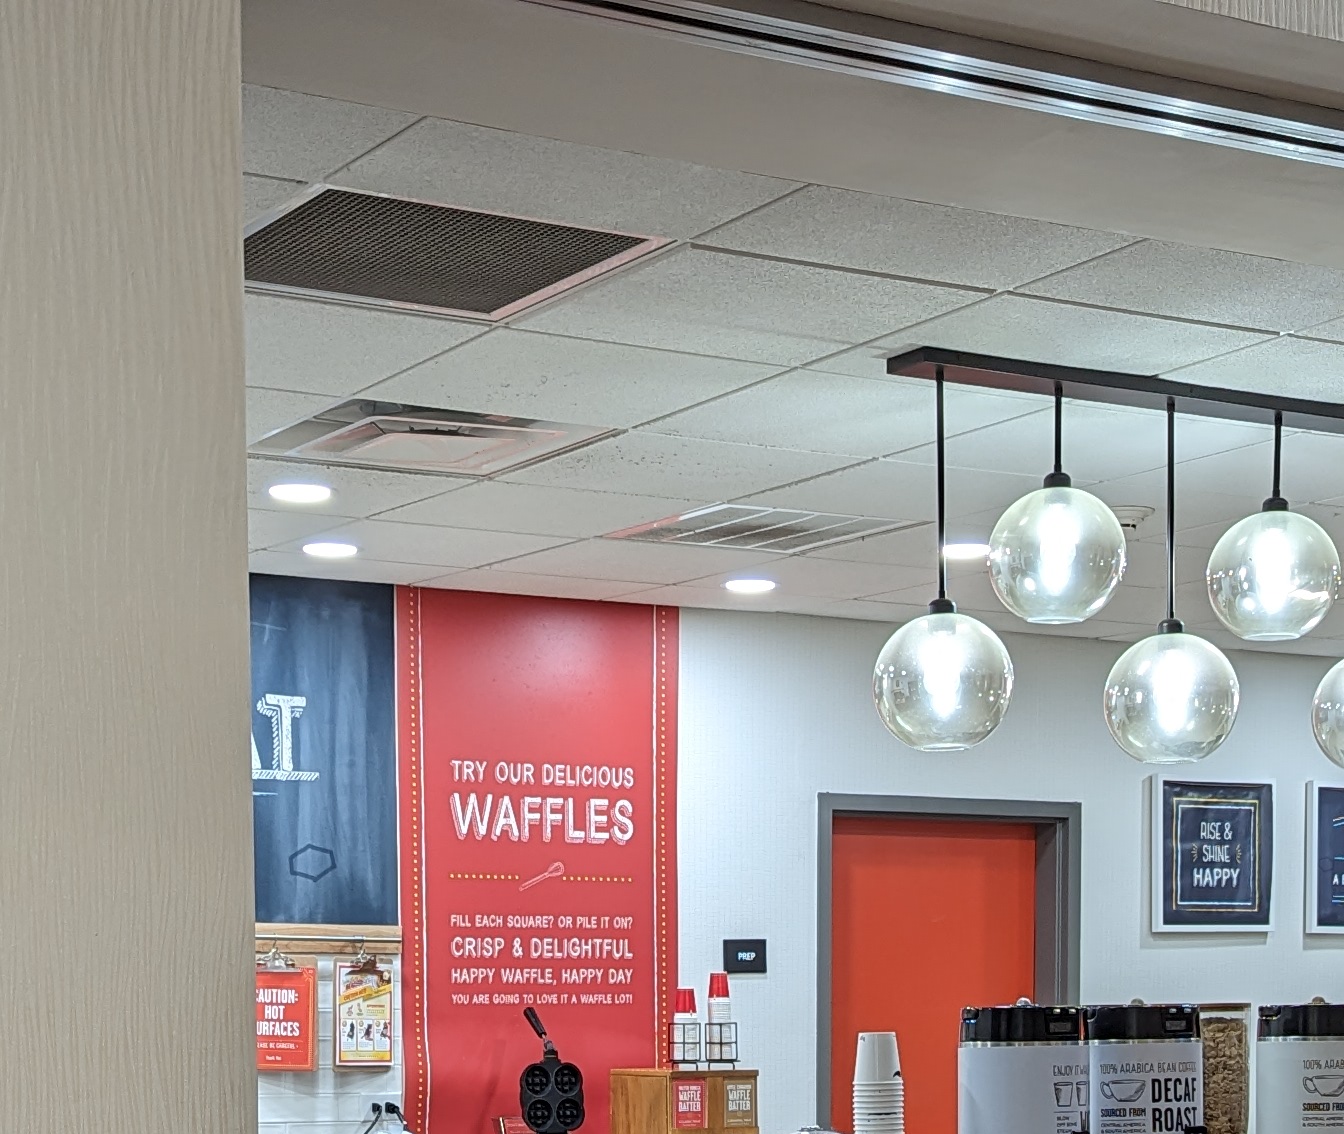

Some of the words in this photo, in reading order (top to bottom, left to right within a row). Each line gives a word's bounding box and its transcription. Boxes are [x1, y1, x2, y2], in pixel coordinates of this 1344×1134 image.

[450, 760, 487, 783] TRY
[495, 761, 535, 785] OUR
[542, 764, 634, 789] DELICIOUS
[450, 792, 634, 845] WAFFLES
[1200, 822, 1221, 840] RISE
[1223, 823, 1233, 840] &
[1202, 845, 1230, 863] SHINE
[1193, 868, 1240, 888] HAPPY
[1332, 874, 1339, 885] A
[450, 914, 471, 928] FILL
[475, 915, 503, 928] EACH
[507, 915, 554, 929] SQUARE?
[558, 916, 573, 929] OR
[576, 916, 597, 929] PILE
[600, 916, 610, 929] IT
[613, 916, 633, 929] ON?
[450, 937, 505, 958] CRISP
[512, 937, 523, 958] &
[530, 938, 633, 960] DELIGHTFUL
[737, 952, 756, 961] PREP
[451, 968, 495, 984] HAPPY
[501, 968, 556, 986] WAFFLE,
[561, 968, 604, 985] HAPPY
[608, 968, 633, 985] DAY
[451, 994, 469, 1004] YOU
[472, 994, 490, 1004] ARE
[492, 994, 520, 1005] GOING
[523, 994, 534, 1004] TO
[536, 994, 558, 1004] LOVE
[560, 994, 569, 1004] IT
[571, 994, 578, 1004] A
[580, 994, 612, 1004] WAFFLE
[614, 994, 633, 1004] LOT!
[264, 1005, 285, 1020] HOT
[256, 1021, 300, 1037] URFACES
[1053, 1065, 1073, 1076] ENJOY
[1099, 1063, 1118, 1074] 100%
[1120, 1063, 1155, 1073] ARABICA
[1158, 1062, 1176, 1073] BEAN
[1302, 1060, 1322, 1070] 100%
[678, 1090, 701, 1101] WAFFLE
[728, 1089, 751, 1100] WAFFLE
[1151, 1077, 1197, 1103] DECAF
[678, 1101, 701, 1112] BATTER
[728, 1100, 751, 1111] BATTER
[1100, 1108, 1127, 1118] SOURCED
[1129, 1107, 1146, 1117] FROM
[1152, 1107, 1197, 1133] ROAST
